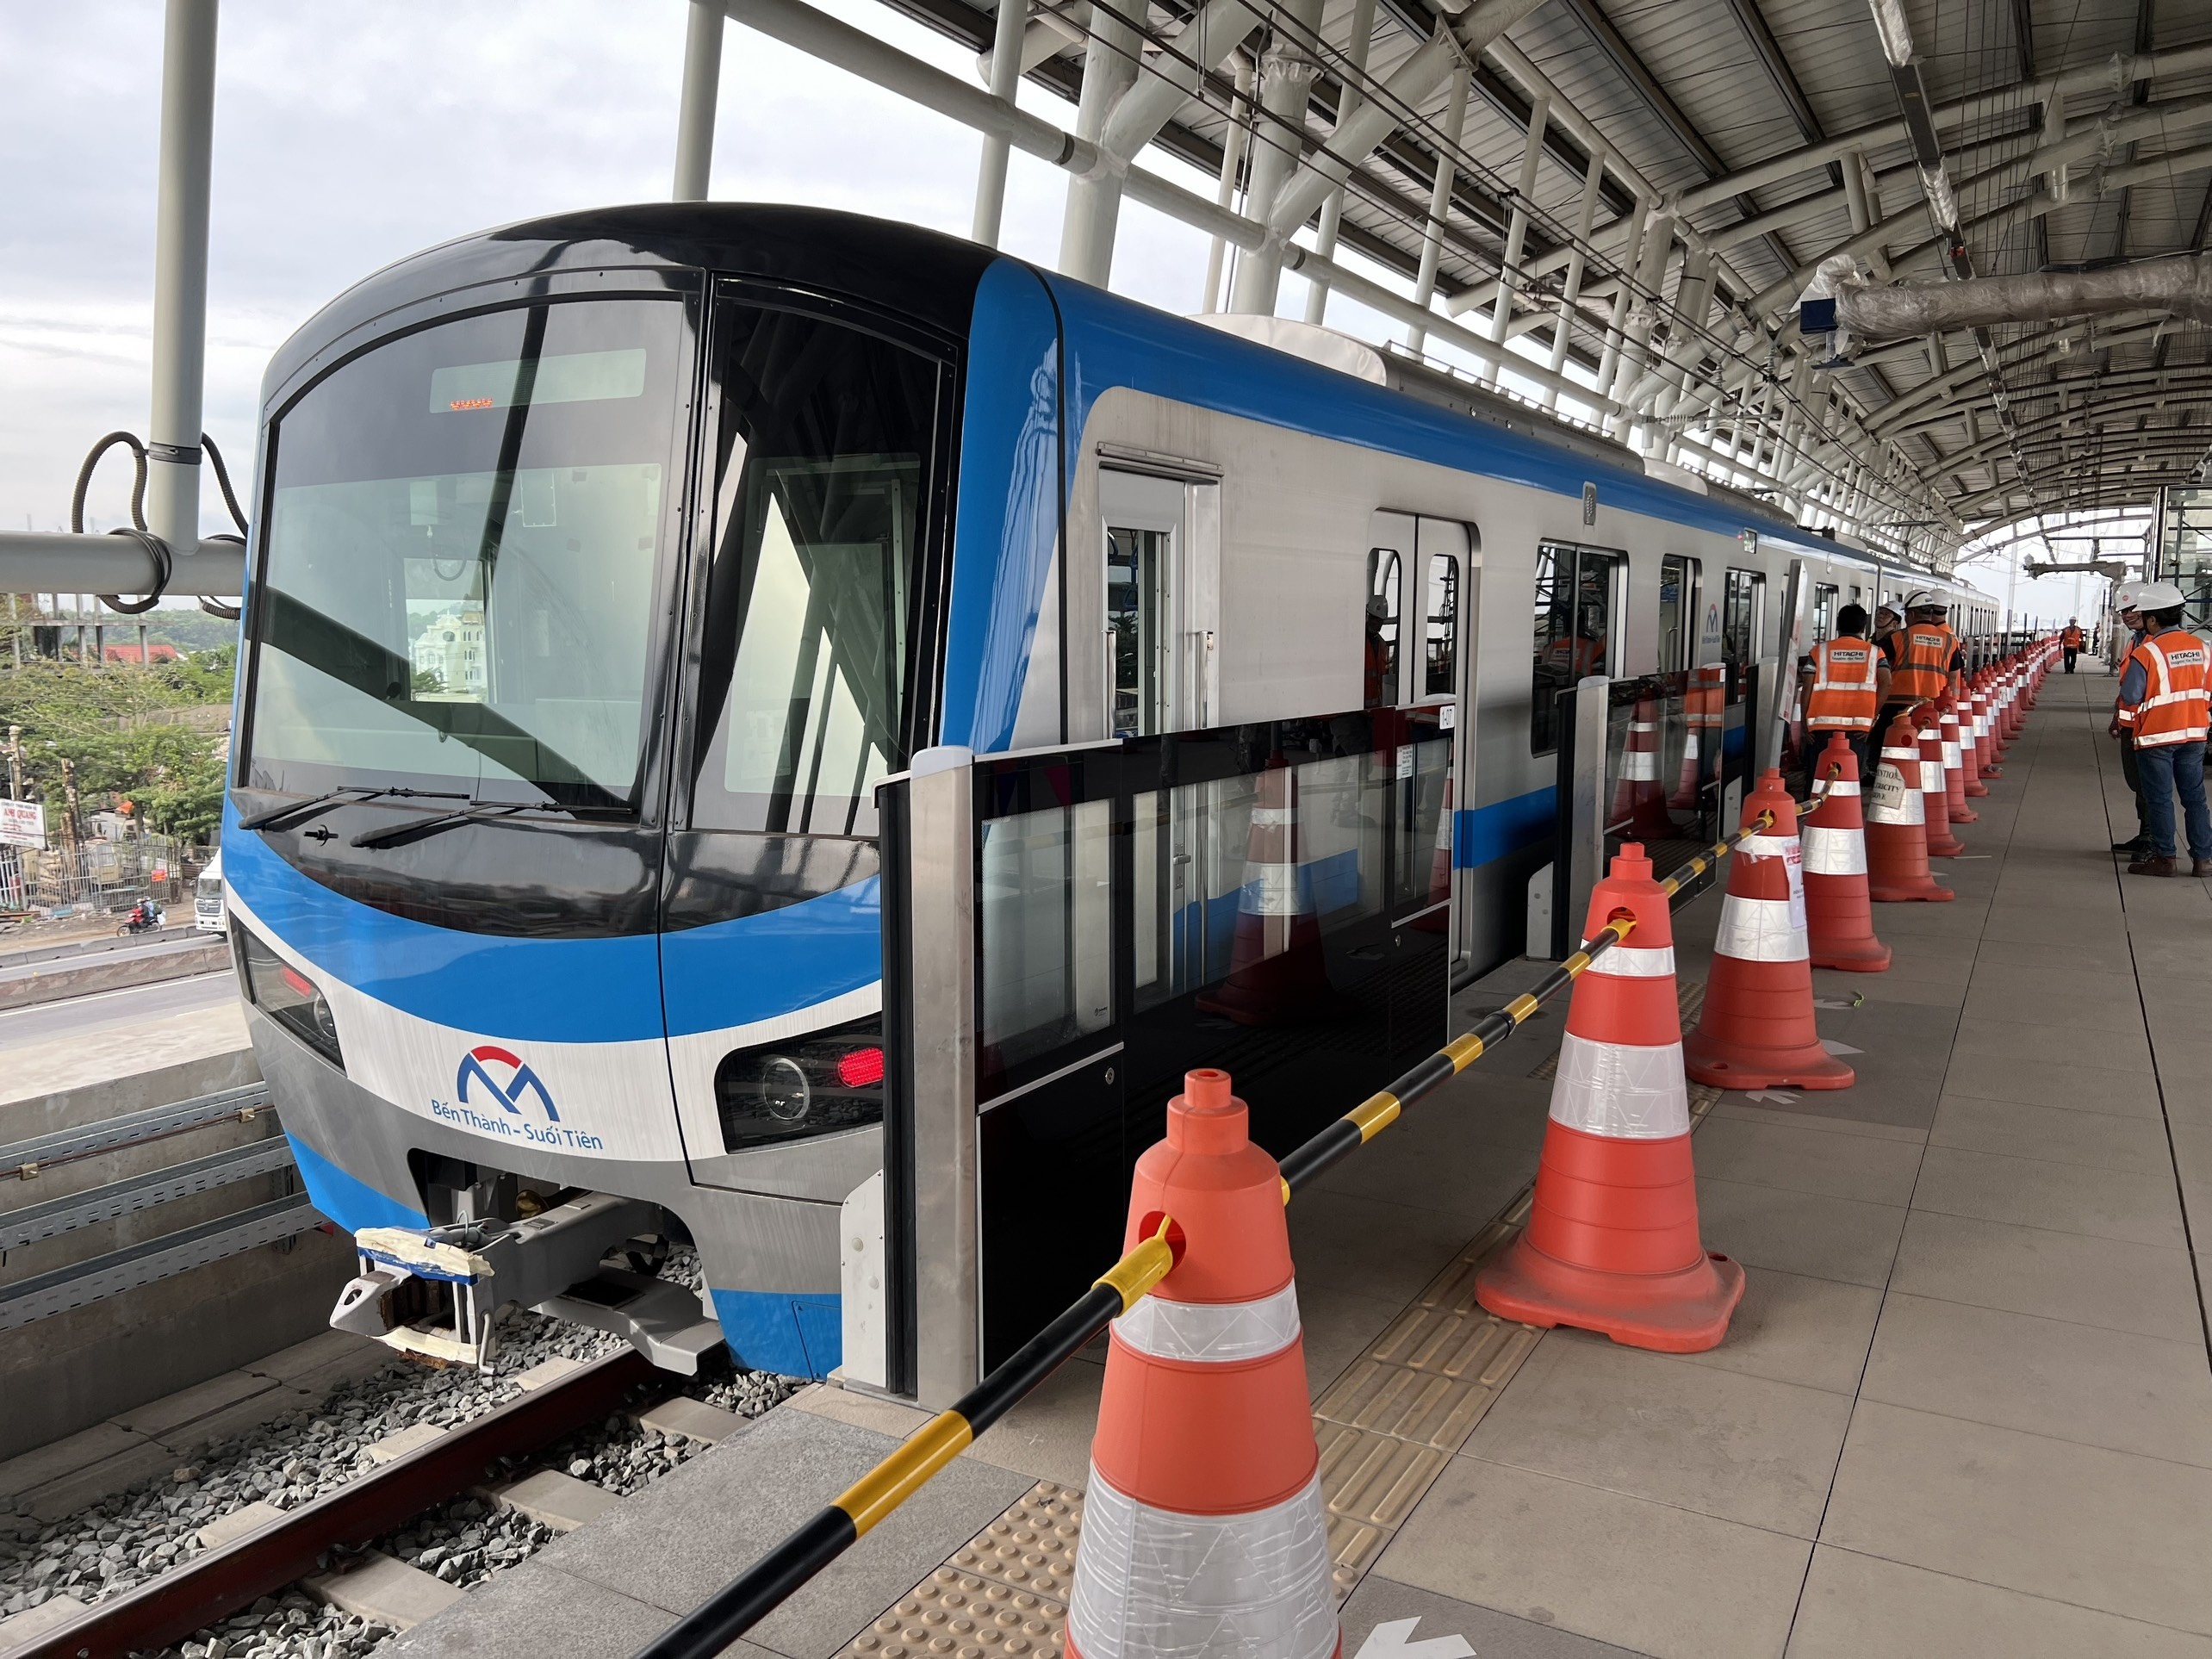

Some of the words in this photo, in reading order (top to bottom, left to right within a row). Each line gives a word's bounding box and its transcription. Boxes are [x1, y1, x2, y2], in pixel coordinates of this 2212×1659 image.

[2171, 651, 2200, 660] HITACHI
[431, 1099, 460, 1121] Bến
[460, 1108, 512, 1136] Thành
[524, 1123, 562, 1146] Suối
[563, 1129, 604, 1150] Tiên
